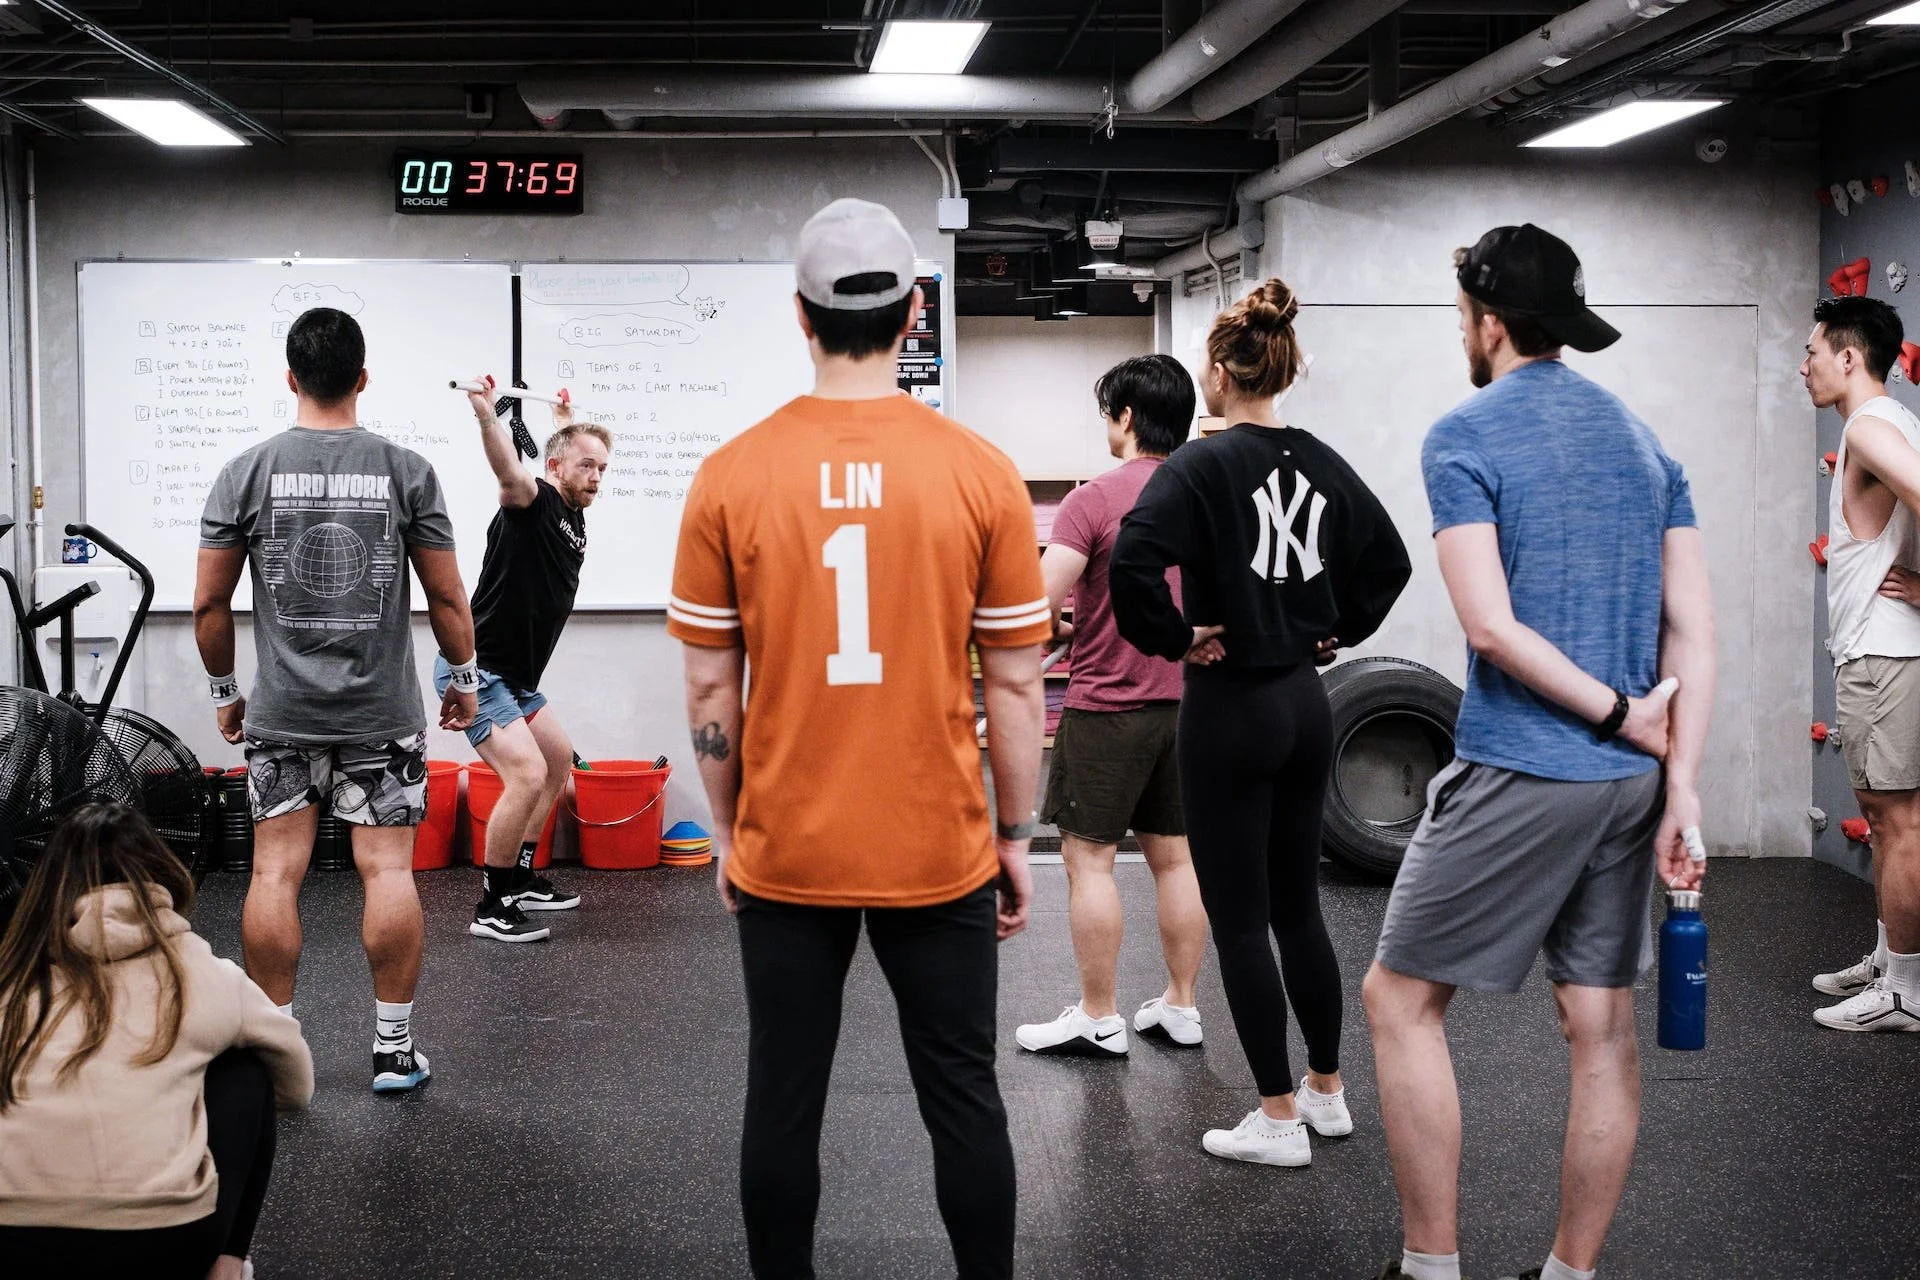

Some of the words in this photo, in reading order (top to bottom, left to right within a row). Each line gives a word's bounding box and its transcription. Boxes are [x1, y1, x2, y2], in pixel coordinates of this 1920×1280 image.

[401, 161, 453, 194] 00
[465, 161, 578, 195] 37:69
[402, 197, 449, 207] ROGUE
[167, 322, 201, 333] SNATCH
[207, 322, 247, 333] BALANCE
[574, 327, 602, 338] BIG
[624, 327, 683, 338] SATURDAY
[156, 359, 179, 371] EVERY
[586, 362, 619, 373] TEAMS
[628, 361, 643, 372] OF
[653, 363, 662, 374] 2
[169, 376, 194, 385] POWER
[198, 376, 223, 385] SNATCH
[216, 389, 243, 398] SQUAT
[592, 383, 612, 393] MAX
[616, 383, 636, 393] CALS
[154, 406, 179, 419] EVERY
[586, 411, 616, 422] TEAMS
[625, 412, 640, 421] OF
[650, 412, 658, 422] 2
[167, 425, 201, 435] SANDBAG
[169, 440, 197, 449] SHUTTLE
[201, 440, 218, 449] RUN
[614, 450, 649, 459] BURPEES
[655, 450, 673, 459] OVER
[156, 463, 190, 474] AMRAP
[610, 468, 636, 478] HANG
[642, 468, 671, 478] POWER
[270, 473, 325, 498] HARD
[327, 474, 392, 499] WORK
[820, 462, 882, 509] LIN
[612, 487, 635, 498] FRONT
[643, 487, 672, 499] SQUATS
[822, 523, 883, 686] 1
